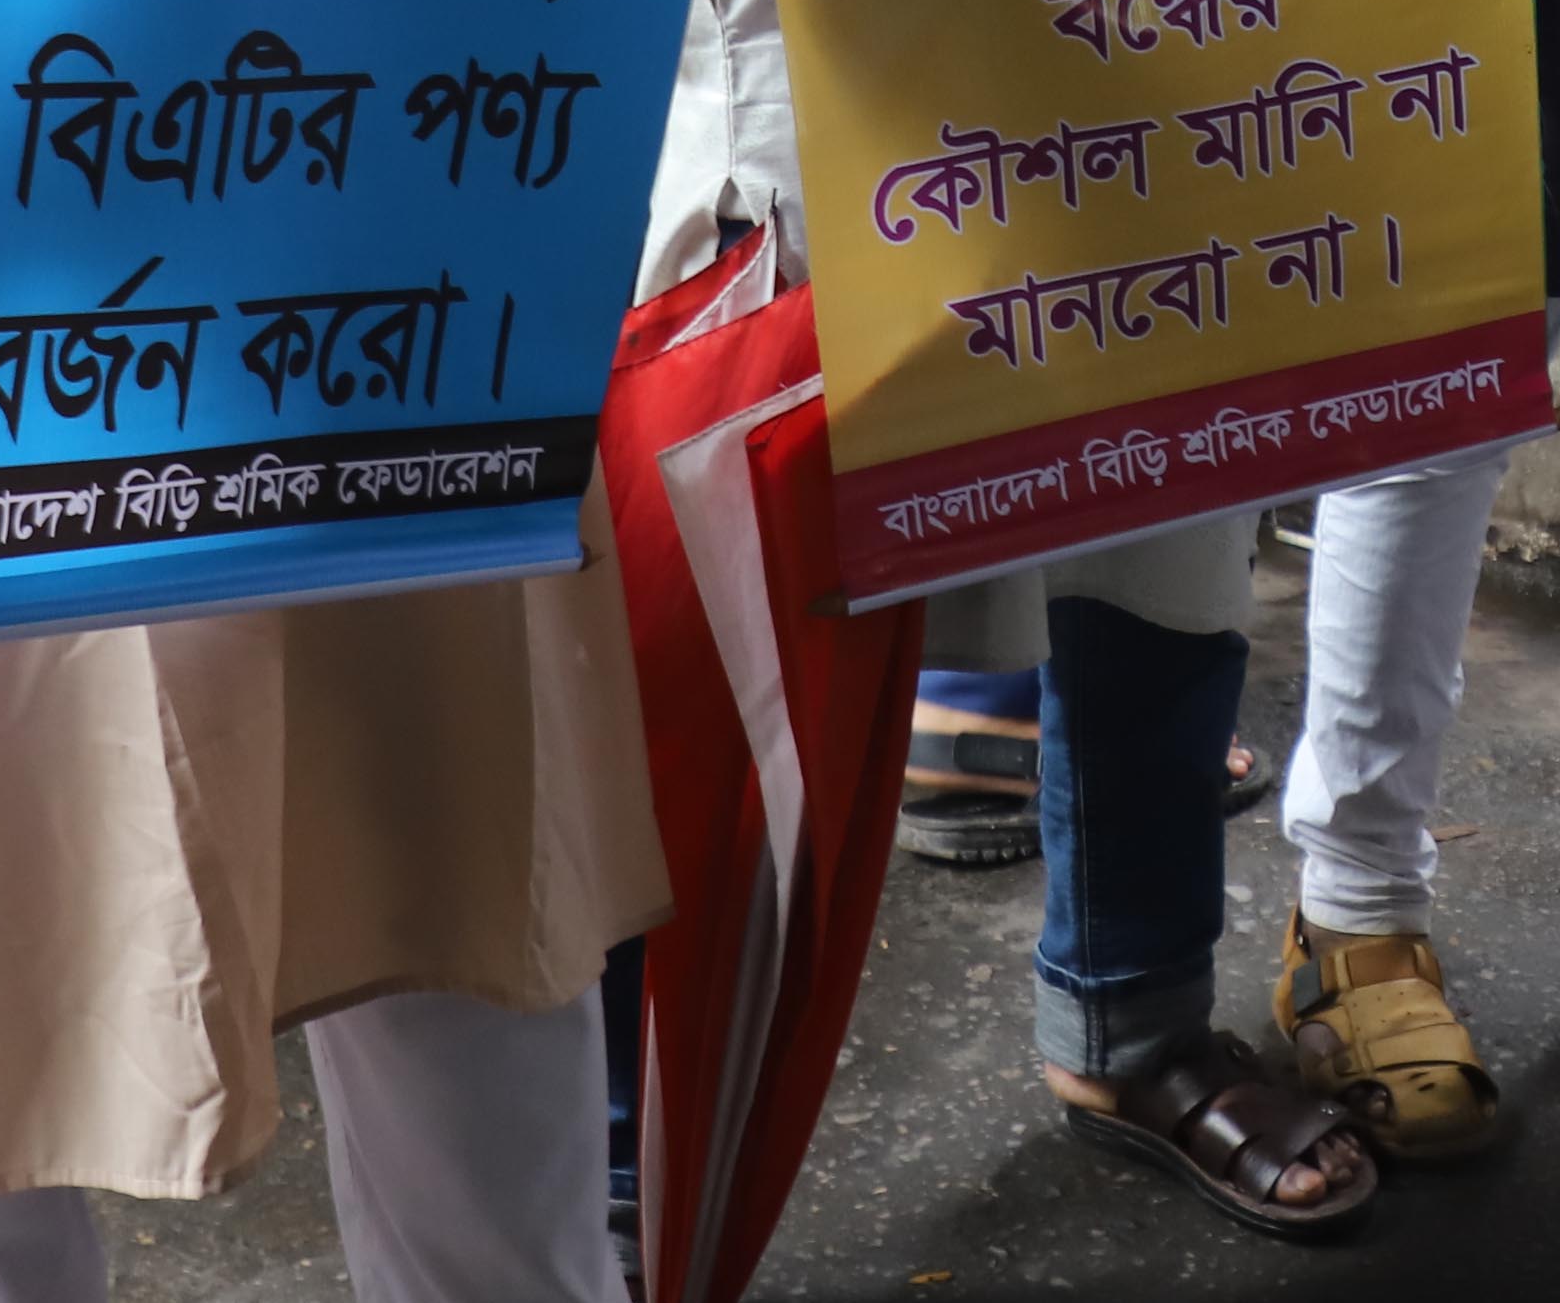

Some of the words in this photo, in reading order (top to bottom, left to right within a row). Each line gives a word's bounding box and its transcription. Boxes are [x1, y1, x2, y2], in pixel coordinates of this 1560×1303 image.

[13, 31, 376, 210] বিএটির
[405, 53, 601, 191] পণ্য
[870, 113, 1161, 244] কৌশল
[1178, 58, 1365, 181] মানি
[1378, 45, 1481, 143] না
[945, 235, 1240, 371] মানবো
[115, 462, 206, 537] বিড়ি
[214, 453, 326, 521] শ্রমিক
[336, 443, 545, 512] ফেডারেশন
[878, 460, 1072, 544] বাংলাদেশ
[1081, 423, 1173, 493] বিড়ি
[1182, 400, 1293, 467] শ্রমিক
[1303, 355, 1507, 441] ফেডারেশন
